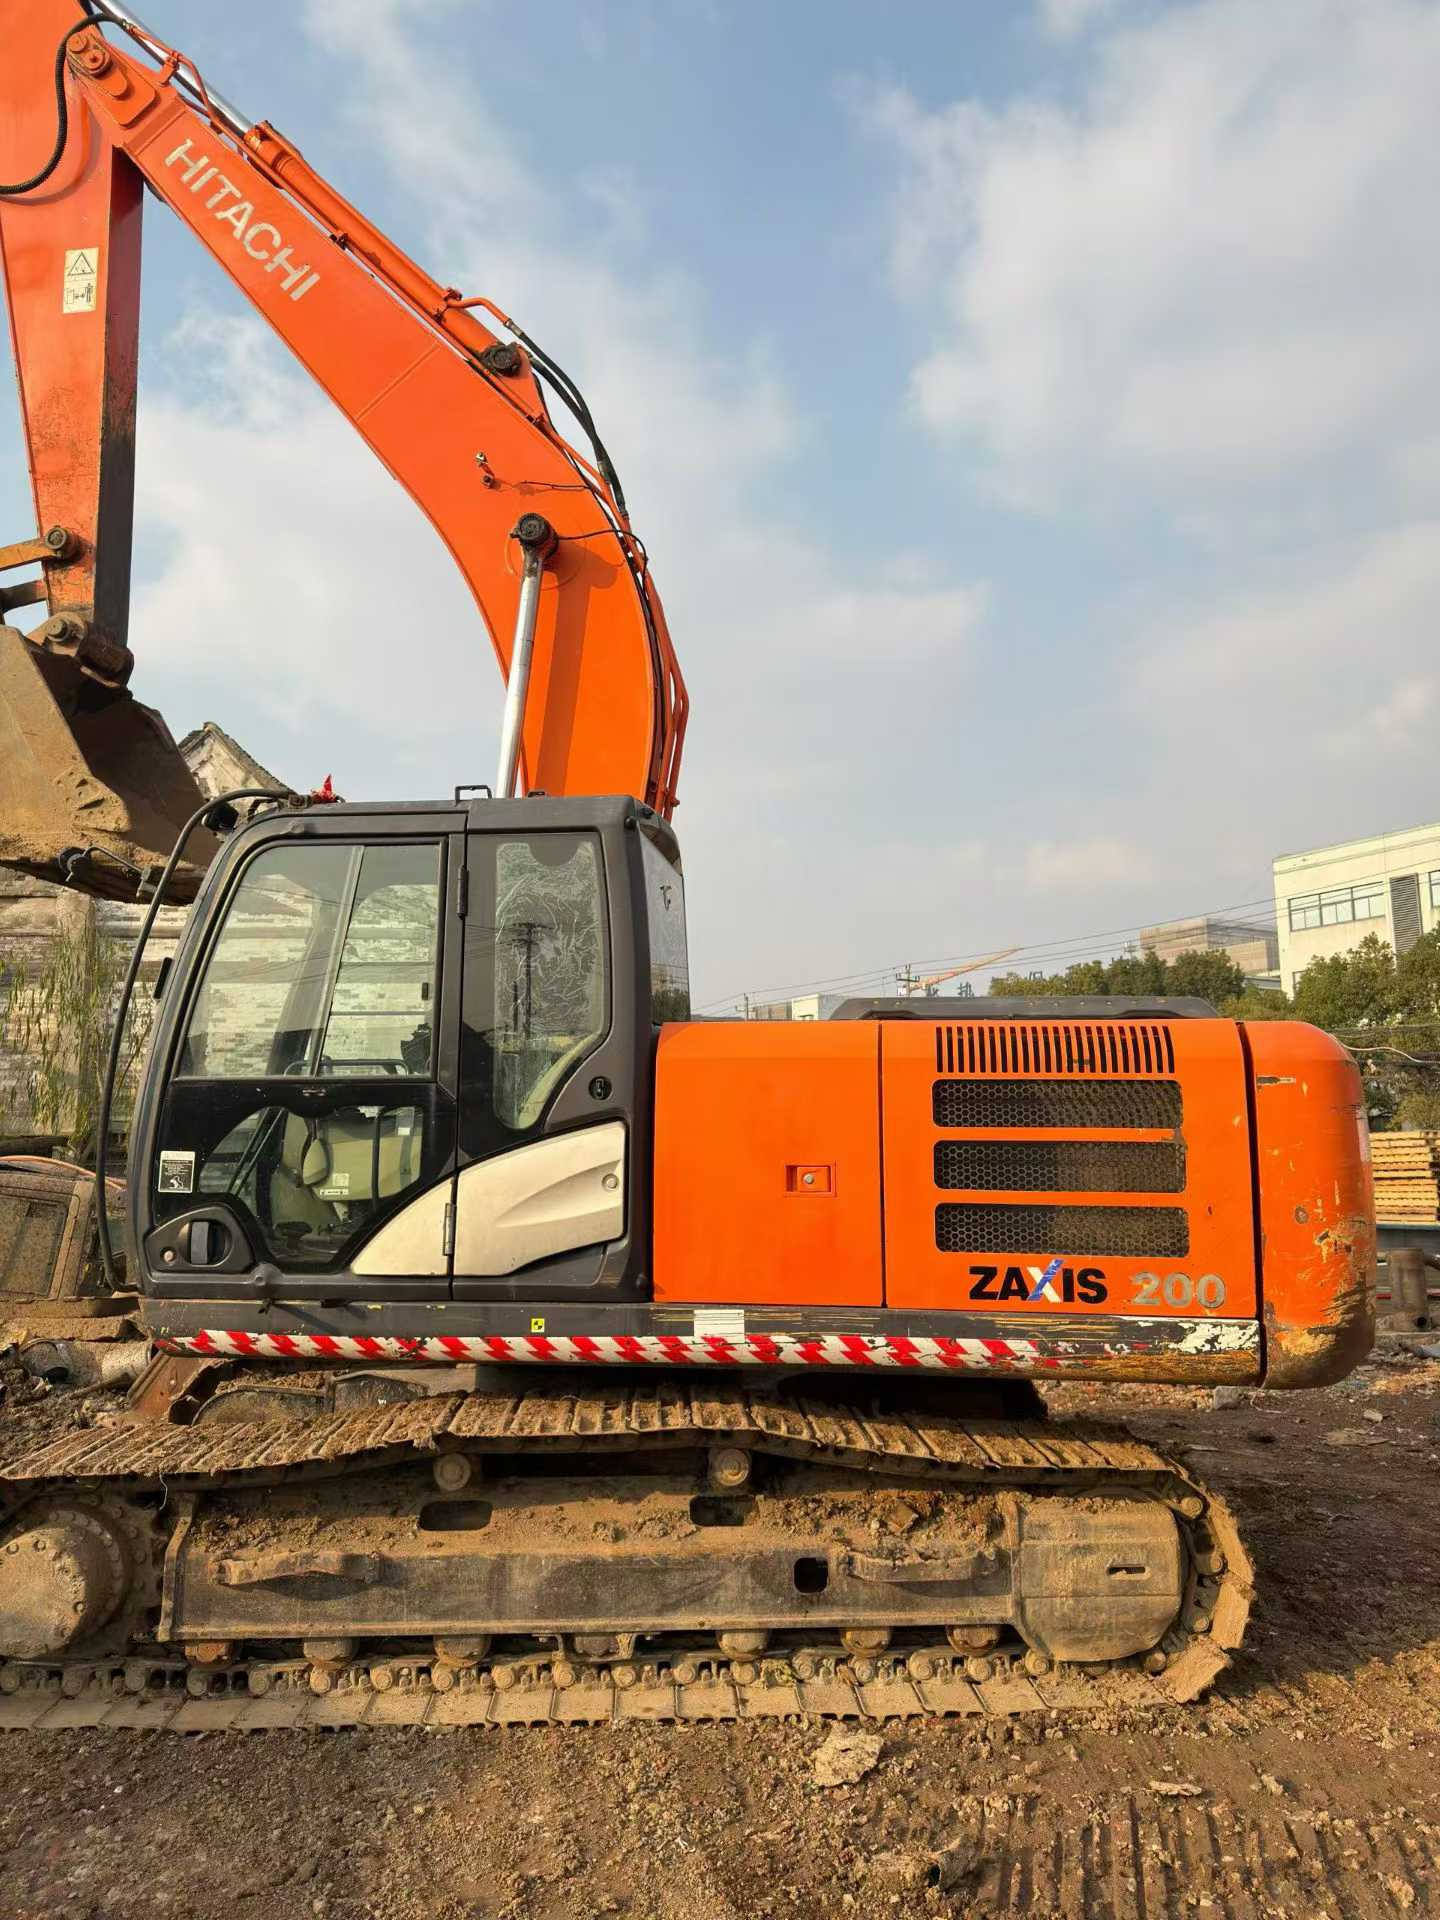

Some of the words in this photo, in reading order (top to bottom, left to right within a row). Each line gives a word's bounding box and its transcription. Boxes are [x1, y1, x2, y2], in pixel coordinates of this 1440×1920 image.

[165, 138, 320, 301] HITACHI
[968, 1259, 1108, 1304] ZAXIS
[1130, 1272, 1226, 1308] 200
